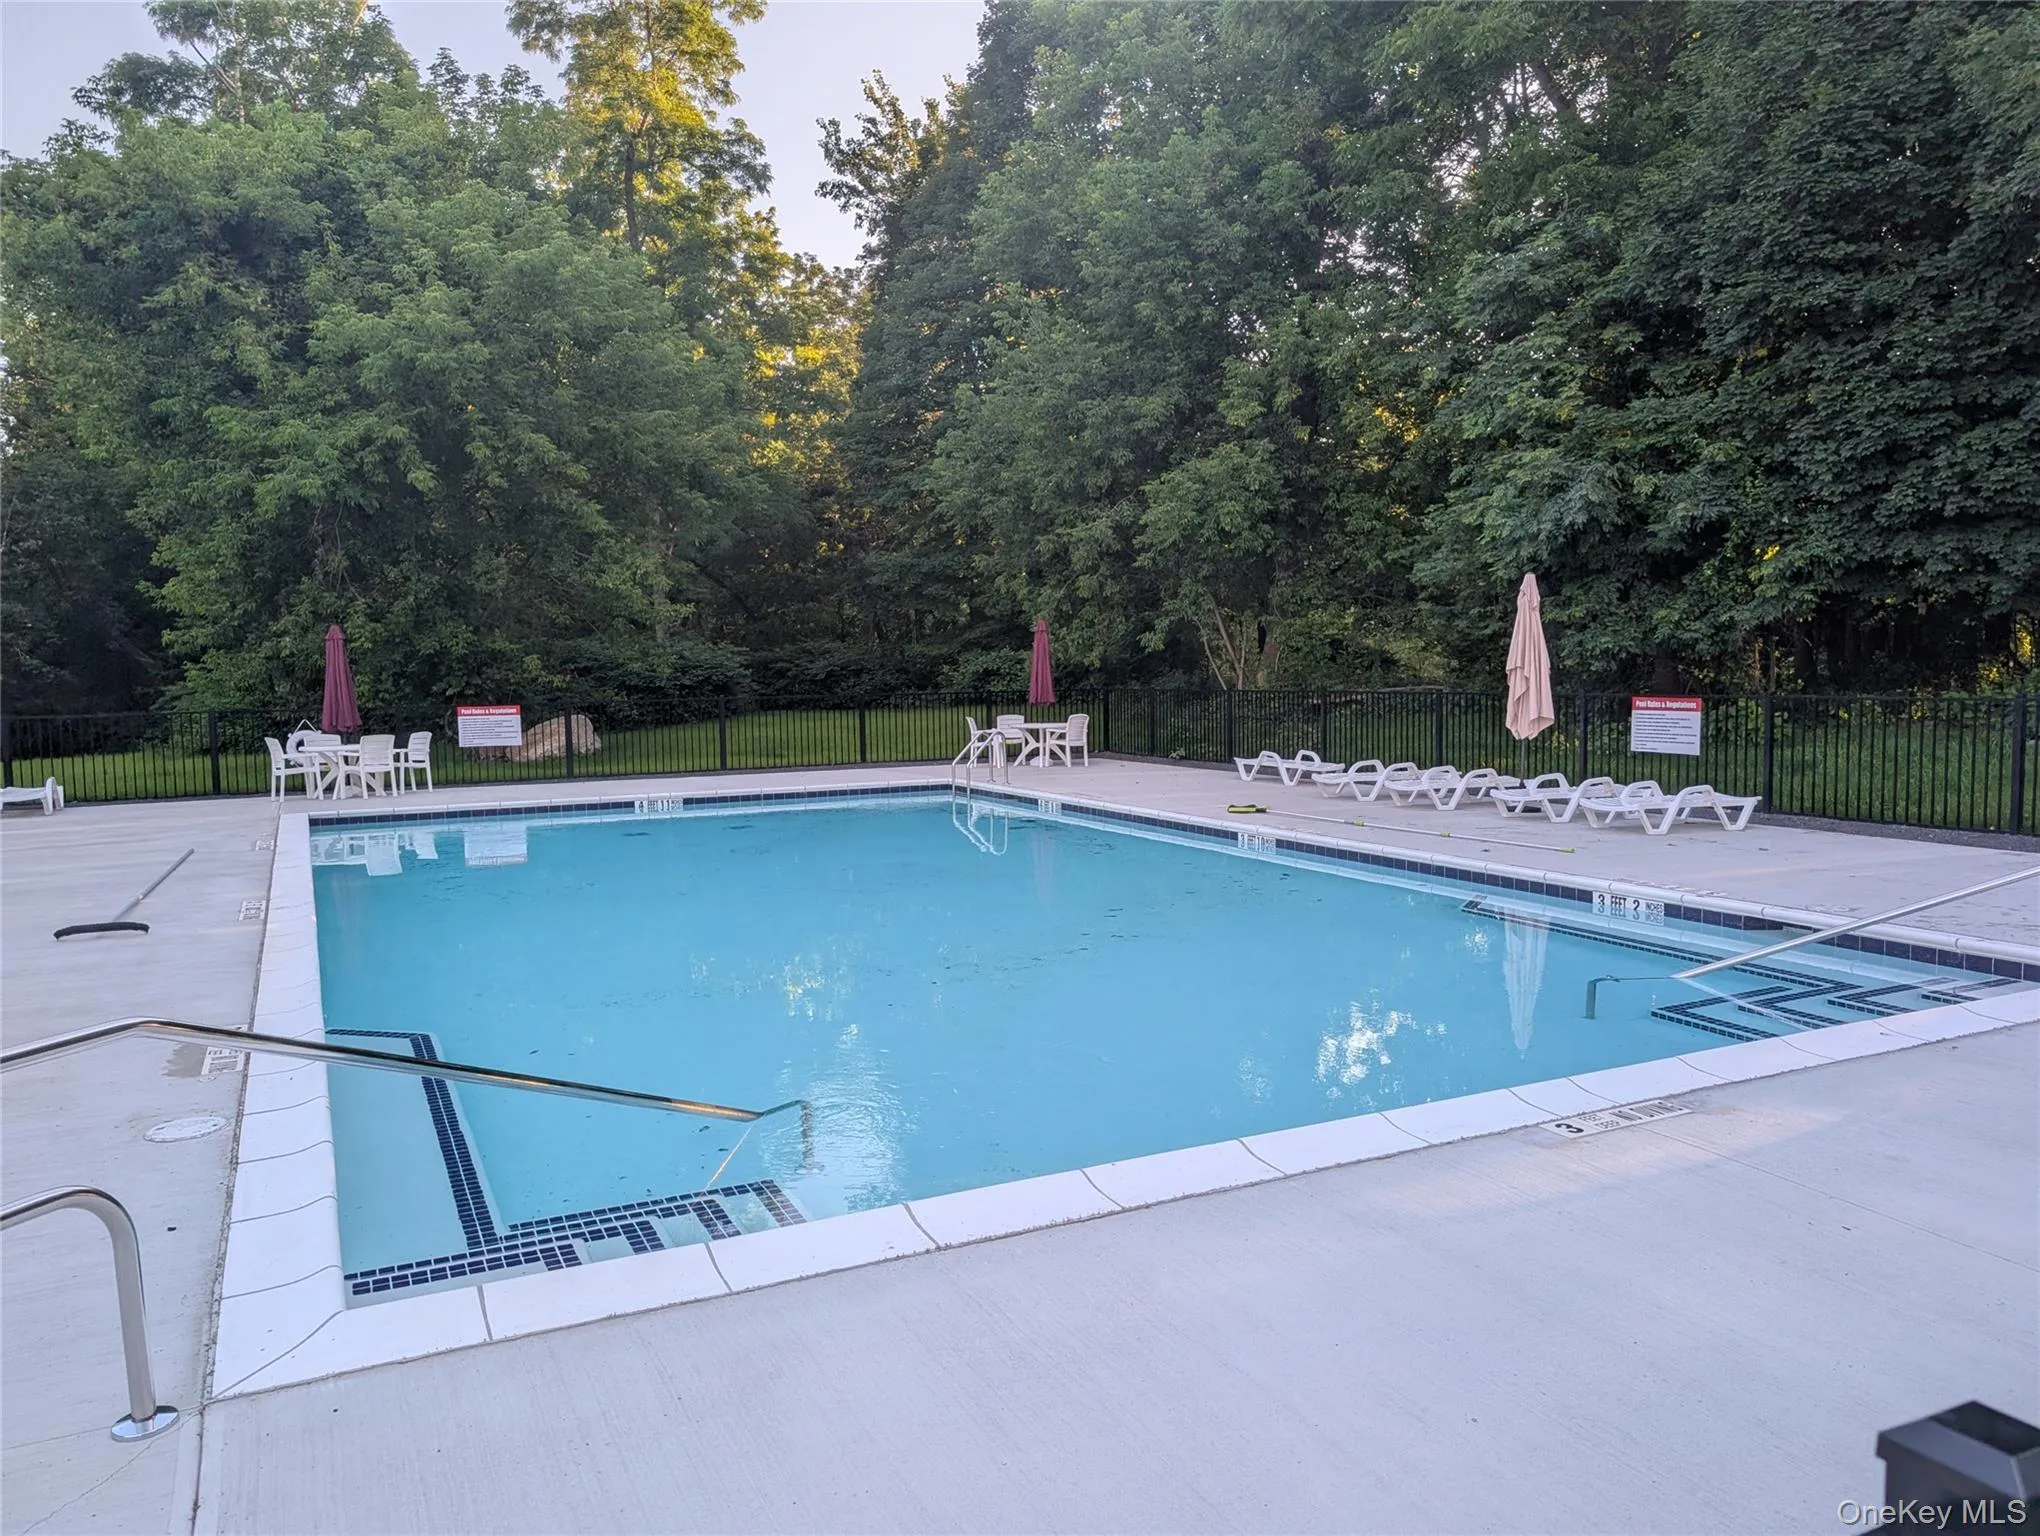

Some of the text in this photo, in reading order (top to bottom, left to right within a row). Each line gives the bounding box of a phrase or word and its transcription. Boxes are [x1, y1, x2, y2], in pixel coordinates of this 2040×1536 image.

[1666, 701, 1697, 709] Regulations
[1598, 894, 1605, 908] 3
[1632, 899, 1640, 912] 2
[1555, 1123, 1584, 1134] 3
